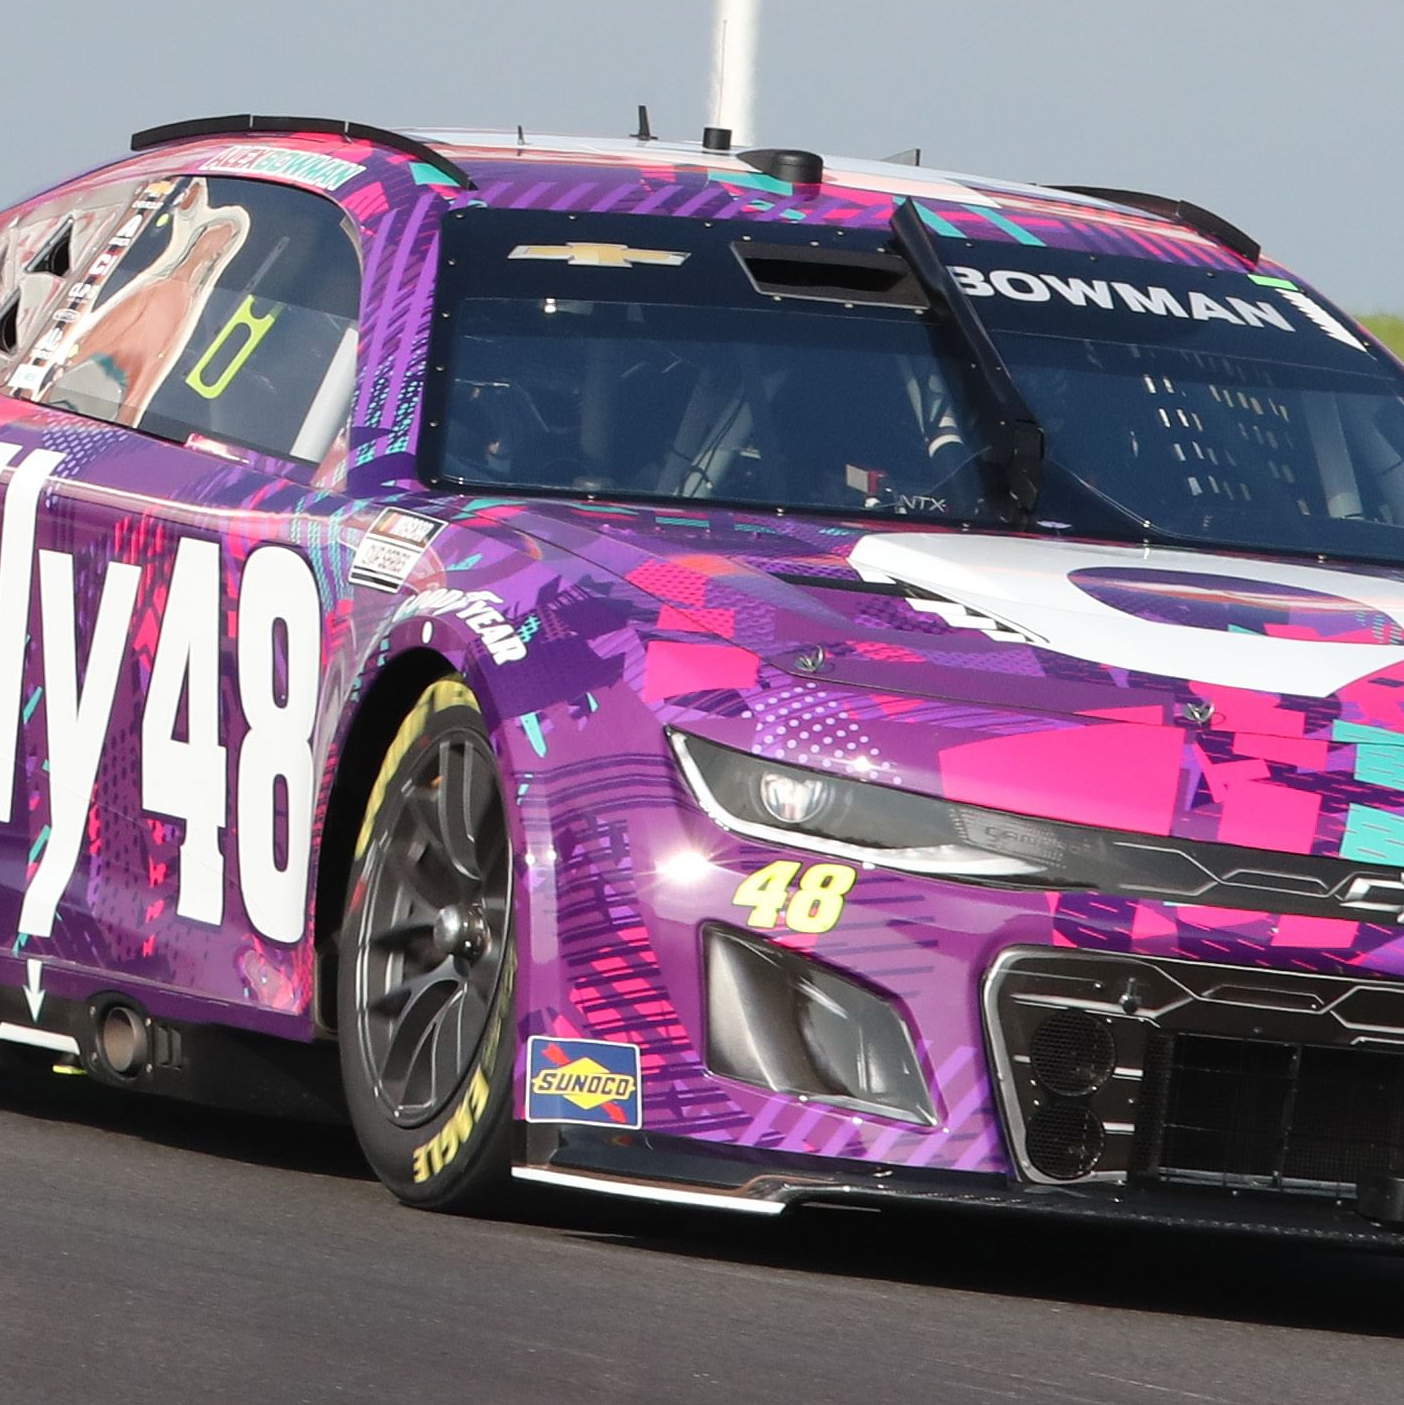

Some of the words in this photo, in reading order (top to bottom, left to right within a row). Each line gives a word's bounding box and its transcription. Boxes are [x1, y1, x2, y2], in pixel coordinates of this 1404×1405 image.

[945, 265, 1297, 333] BOWMAN
[732, 860, 857, 934] 48
[537, 1072, 630, 1096] SUNOCO
[412, 1062, 490, 1184] EAGLE
